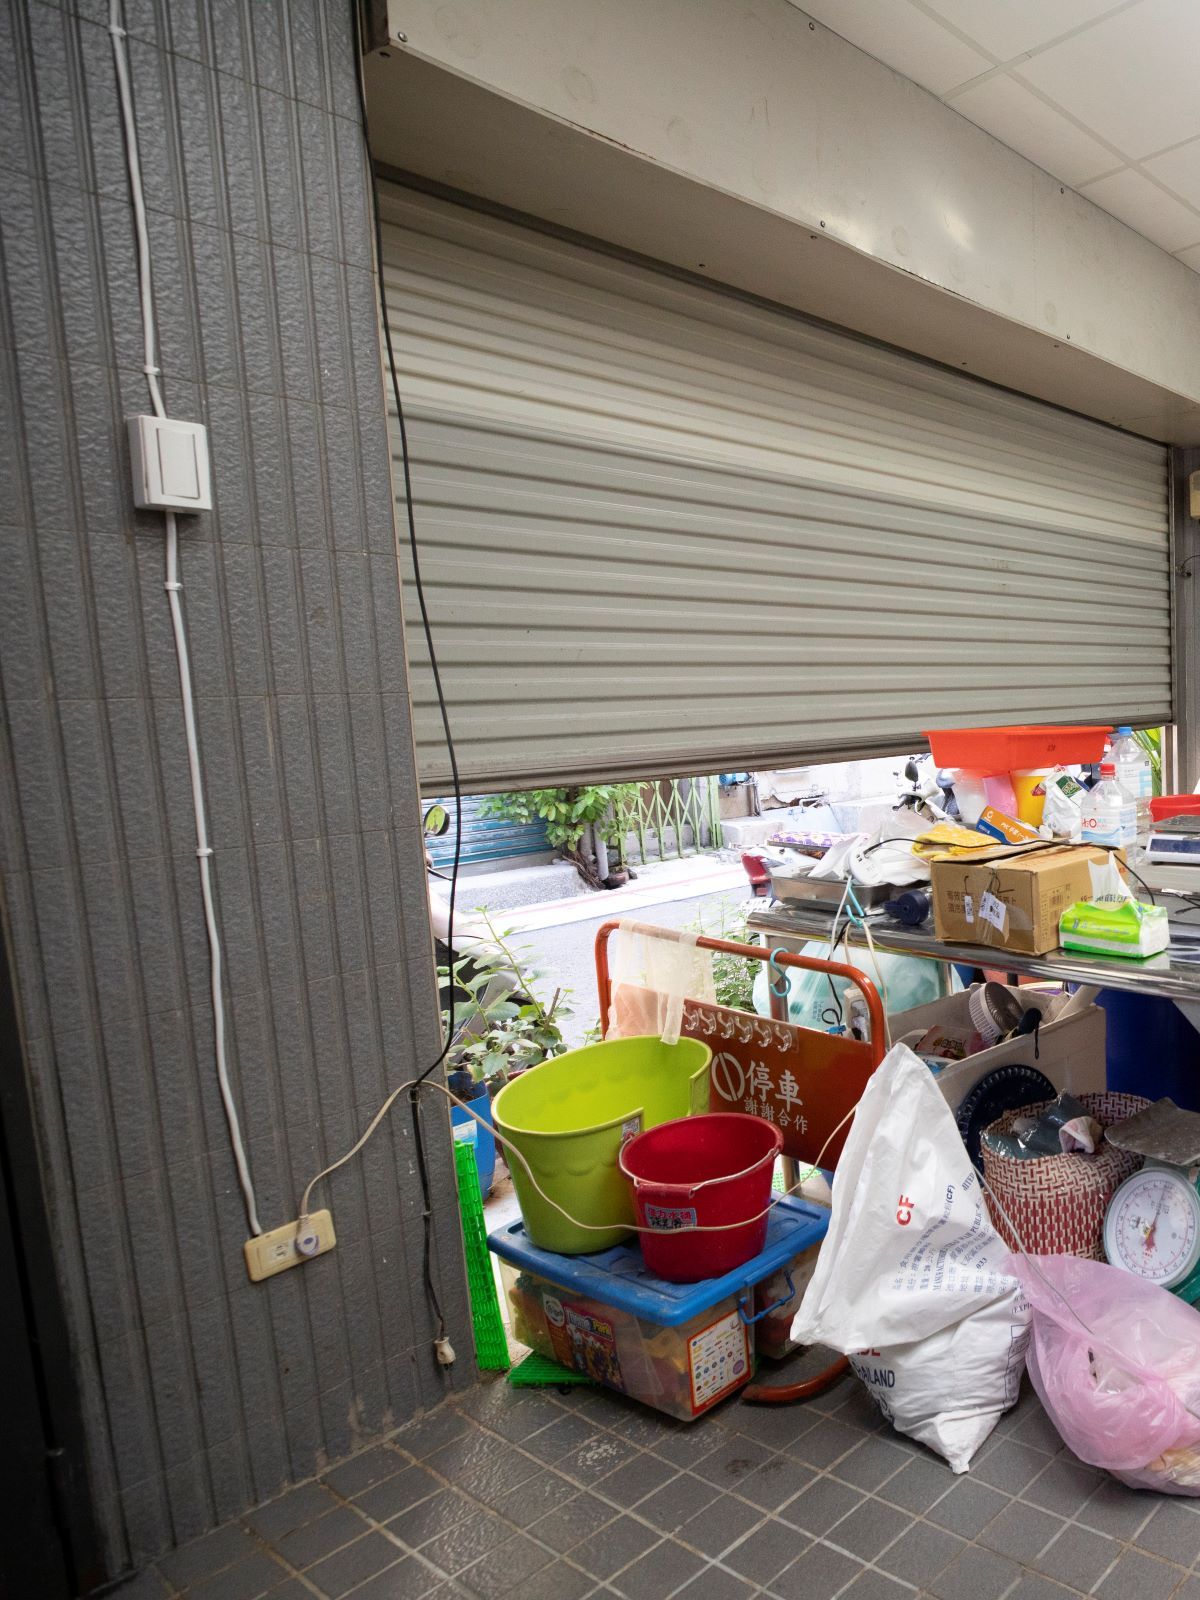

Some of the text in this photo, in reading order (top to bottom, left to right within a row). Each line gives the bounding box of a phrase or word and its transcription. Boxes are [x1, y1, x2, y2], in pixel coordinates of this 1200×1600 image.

[745, 1060, 804, 1112] 停車
[744, 1096, 808, 1135] 謝謝合作
[896, 1194, 915, 1226] CF
